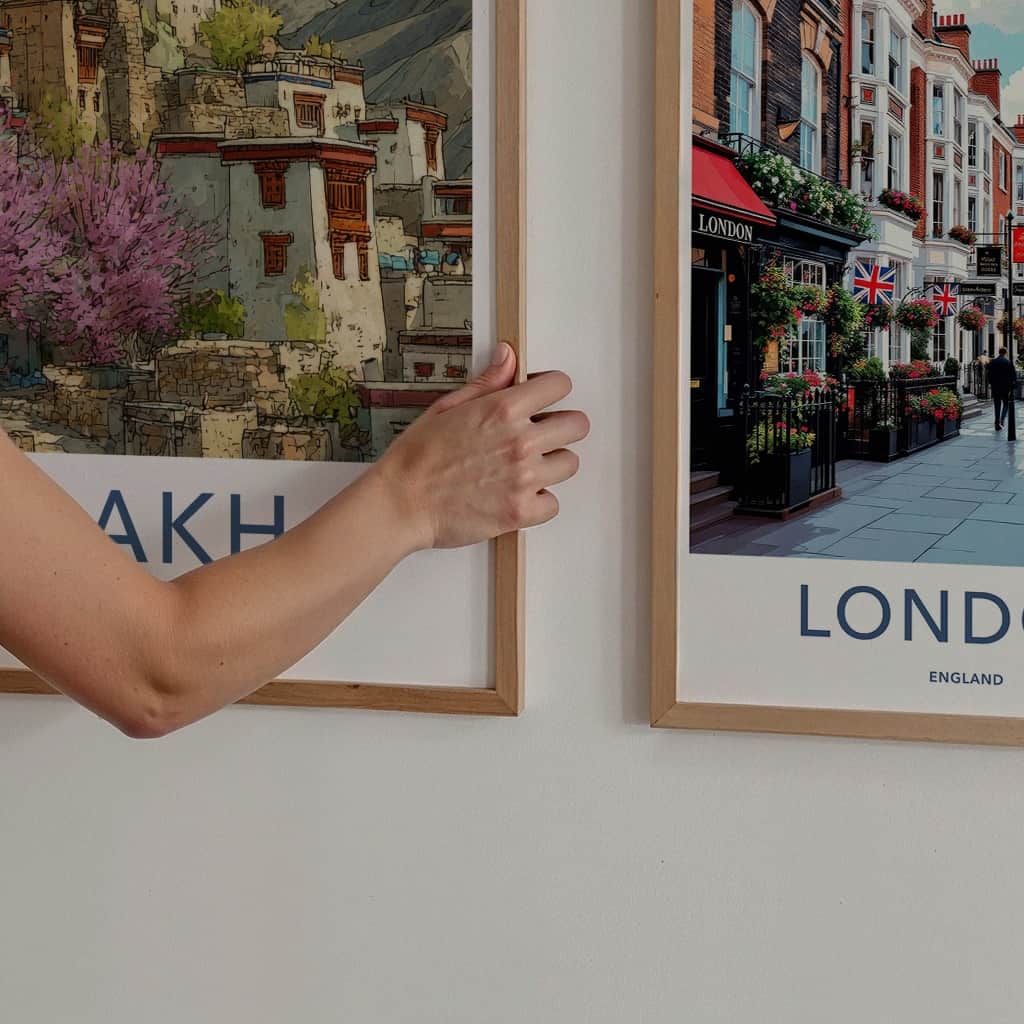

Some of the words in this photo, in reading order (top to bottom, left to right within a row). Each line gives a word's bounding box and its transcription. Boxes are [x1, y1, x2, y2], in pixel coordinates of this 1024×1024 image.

[698, 213, 753, 241] LONDON
[800, 584, 1024, 644] LOND
[929, 671, 1004, 686] ENGLAND
